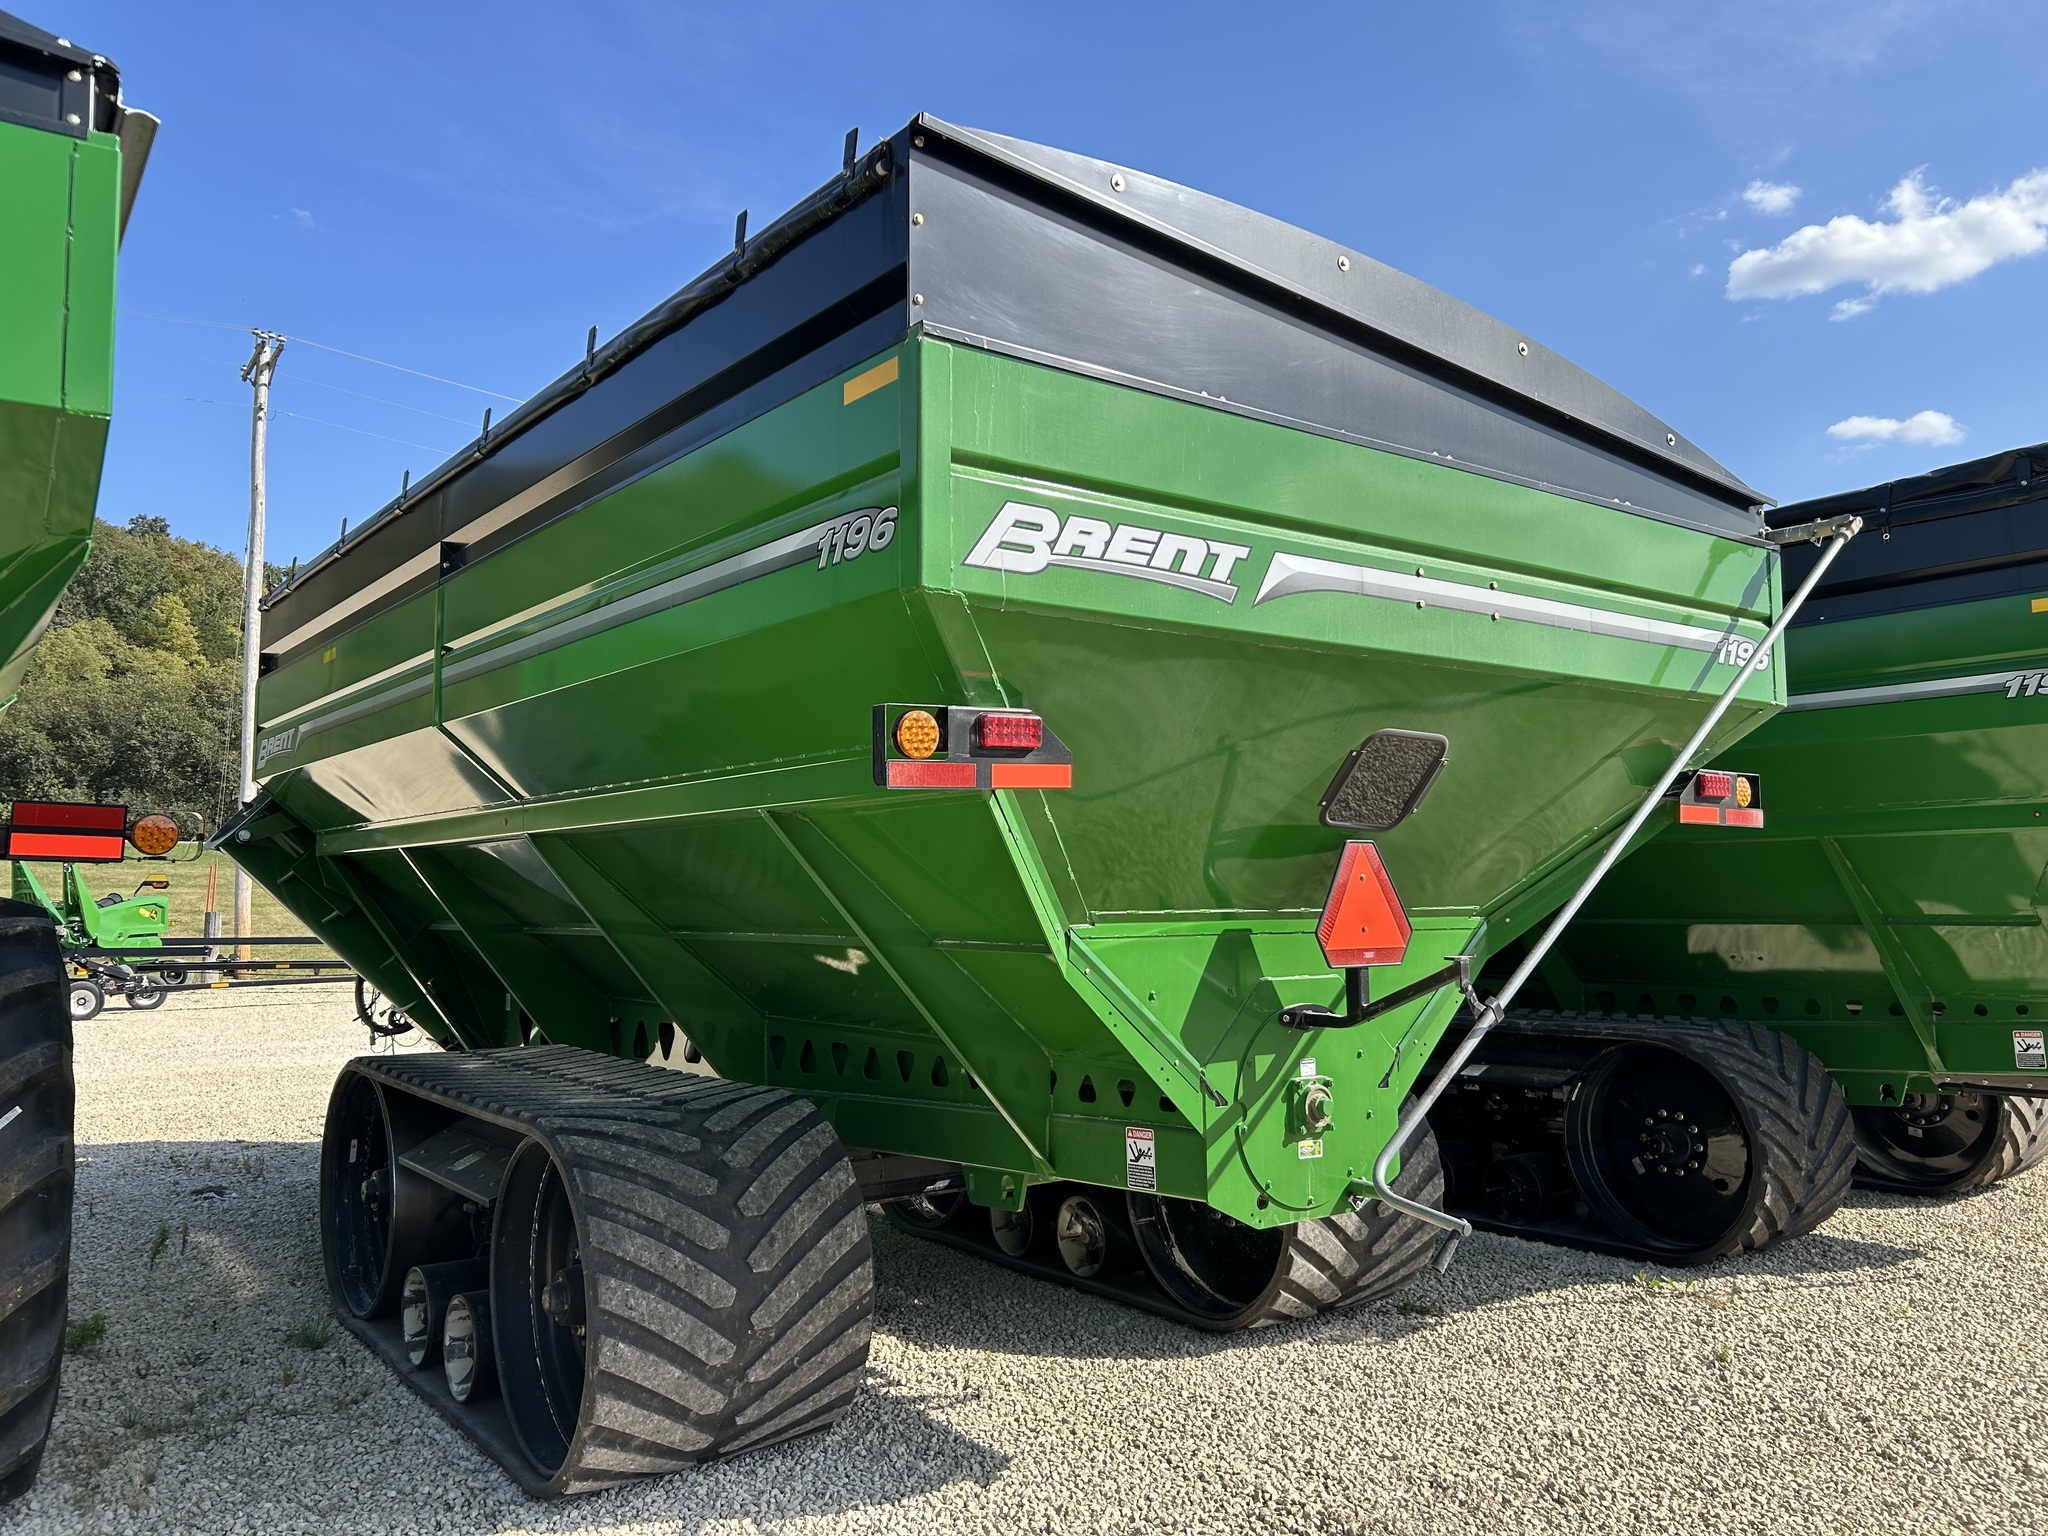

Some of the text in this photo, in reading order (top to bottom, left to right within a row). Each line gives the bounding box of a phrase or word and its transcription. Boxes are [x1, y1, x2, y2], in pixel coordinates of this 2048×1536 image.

[817, 505, 899, 571] 1196
[960, 499, 1253, 584] BRENT
[256, 727, 296, 771] BRENT
[1133, 1130, 1153, 1139] DANGER
